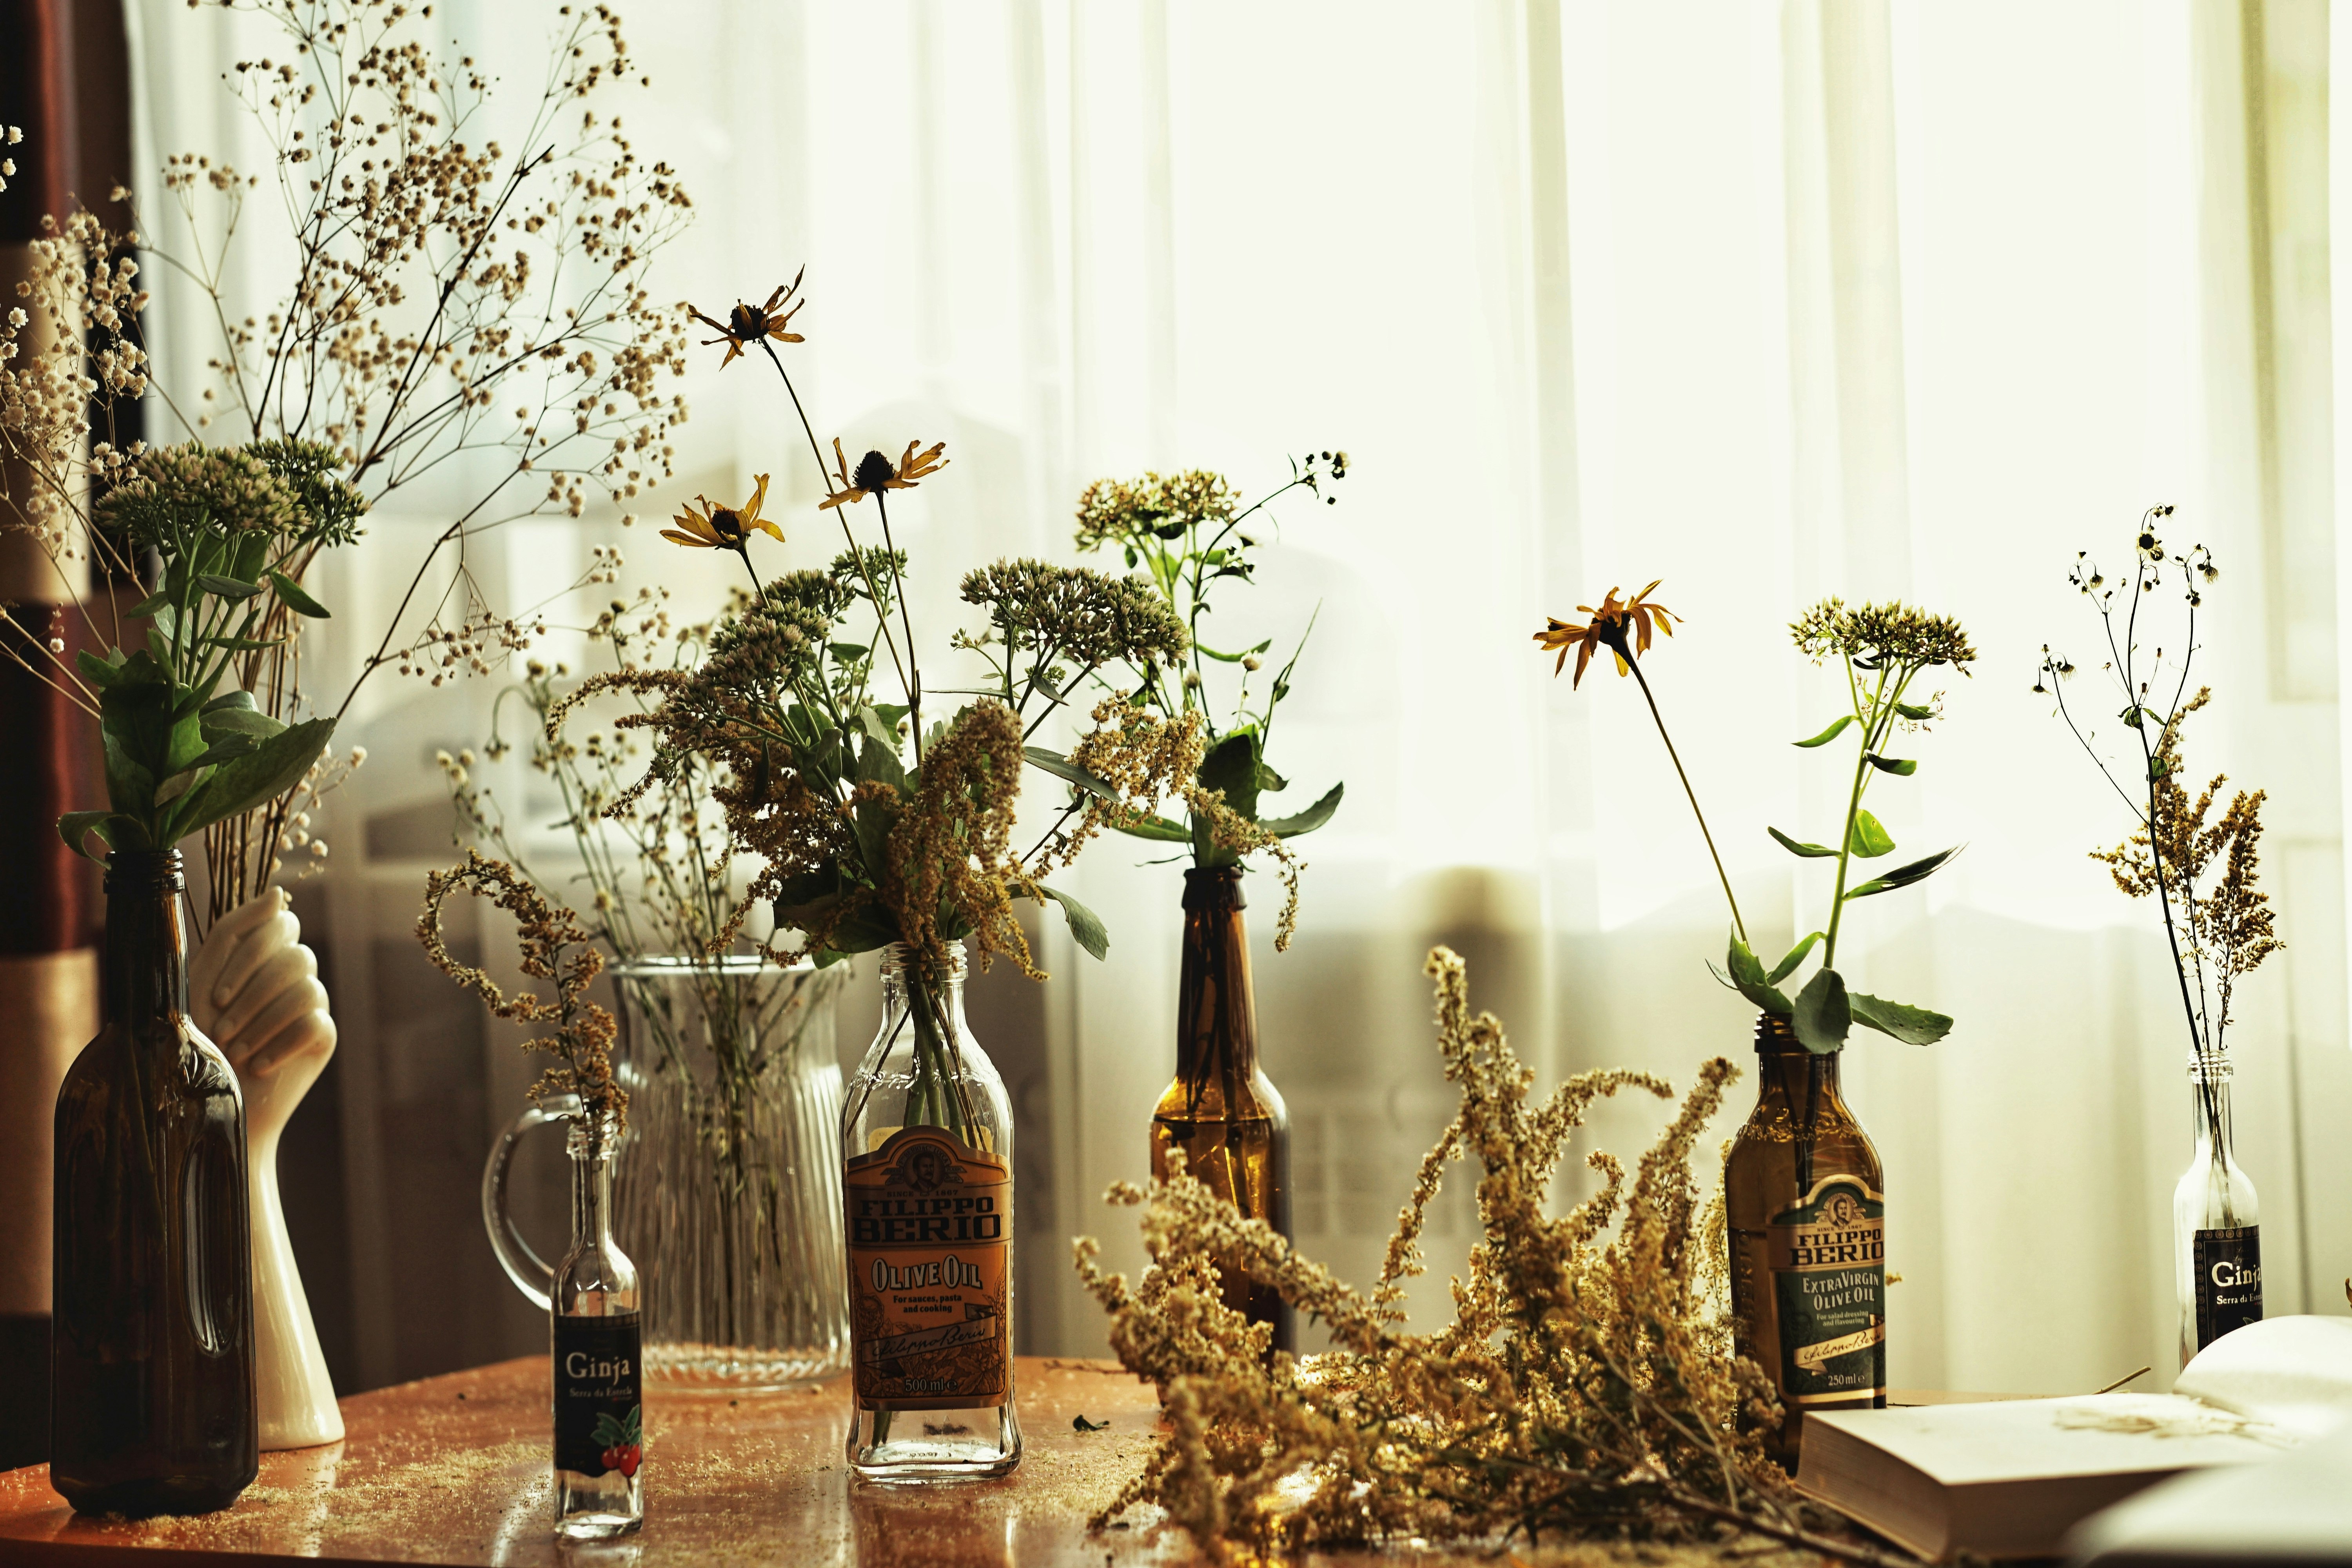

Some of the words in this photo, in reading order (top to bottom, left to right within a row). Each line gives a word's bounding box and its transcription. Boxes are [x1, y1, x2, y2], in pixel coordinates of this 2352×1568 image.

[860, 1196, 994, 1216] FILIPPO
[852, 1214, 1001, 1243] BERIO
[1797, 1228, 1881, 1246] FILIPPO
[1789, 1240, 1884, 1266] BERIO
[871, 1257, 941, 1292] OLIVE
[942, 1254, 984, 1290] OIL
[1802, 1276, 1842, 1294] EXTRA
[1840, 1270, 1879, 1288] VIRGIN
[2211, 1261, 2261, 1292] Ginja
[940, 1294, 962, 1303] pasta
[1813, 1290, 1851, 1311] OLIVE
[1853, 1286, 1875, 1303] OIL
[2217, 1295, 2238, 1305] Serra
[2240, 1294, 2247, 1303] da
[919, 1304, 952, 1313] cooking
[1835, 1317, 1865, 1326] flavouring
[565, 1351, 631, 1386] Ginja
[905, 1379, 927, 1392] 500
[930, 1378, 944, 1391] ml
[1828, 1374, 1844, 1387] 250
[1845, 1373, 1856, 1385] ml
[569, 1387, 592, 1397] Serra
[593, 1388, 604, 1397] da
[606, 1386, 633, 1397] Estrela
